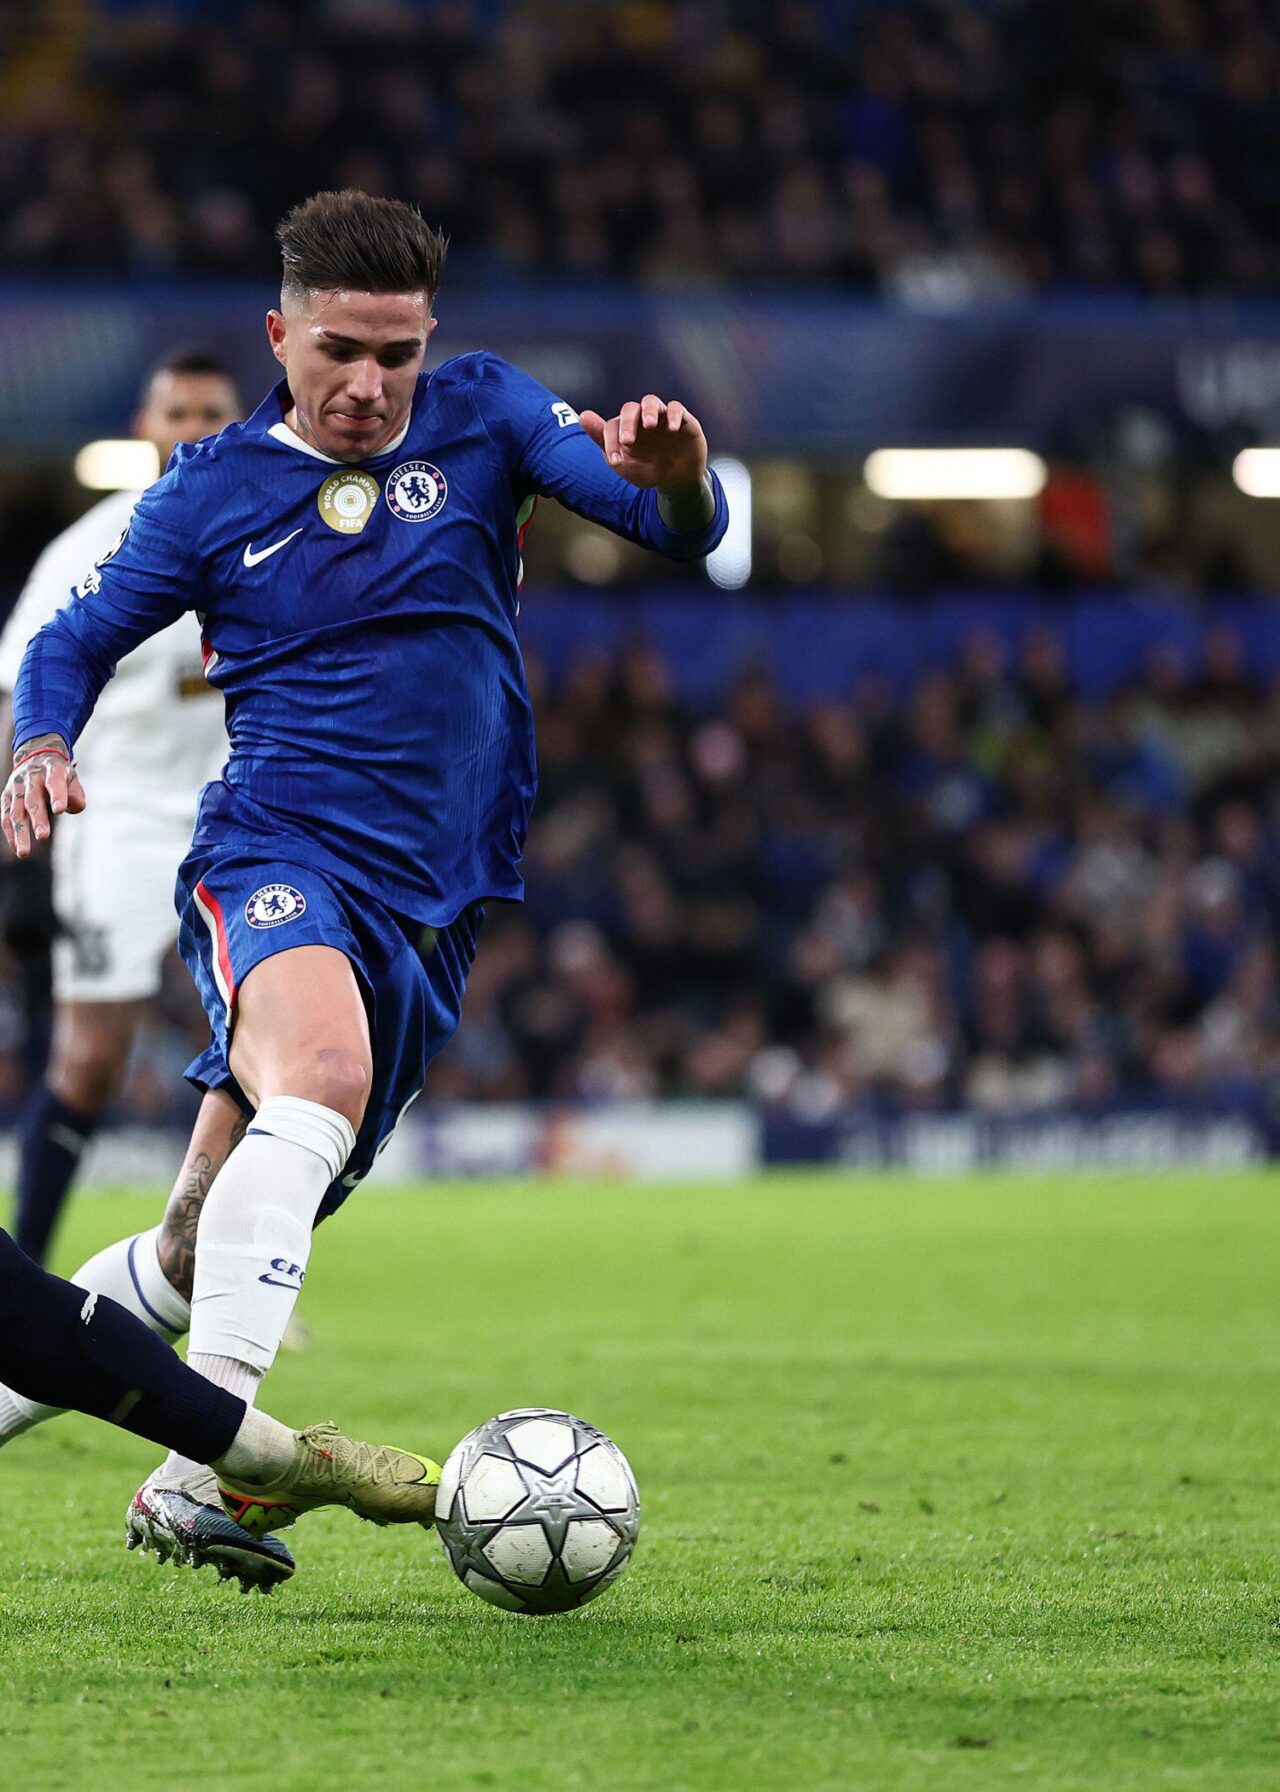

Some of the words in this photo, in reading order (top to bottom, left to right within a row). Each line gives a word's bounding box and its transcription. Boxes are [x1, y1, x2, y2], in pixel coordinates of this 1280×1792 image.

[390, 463, 426, 486] CHELSEA
[324, 480, 340, 510] WORLD
[340, 474, 378, 509] CHAMPIONS
[339, 518, 364, 528] FIFA
[252, 885, 291, 902] CHELSEA
